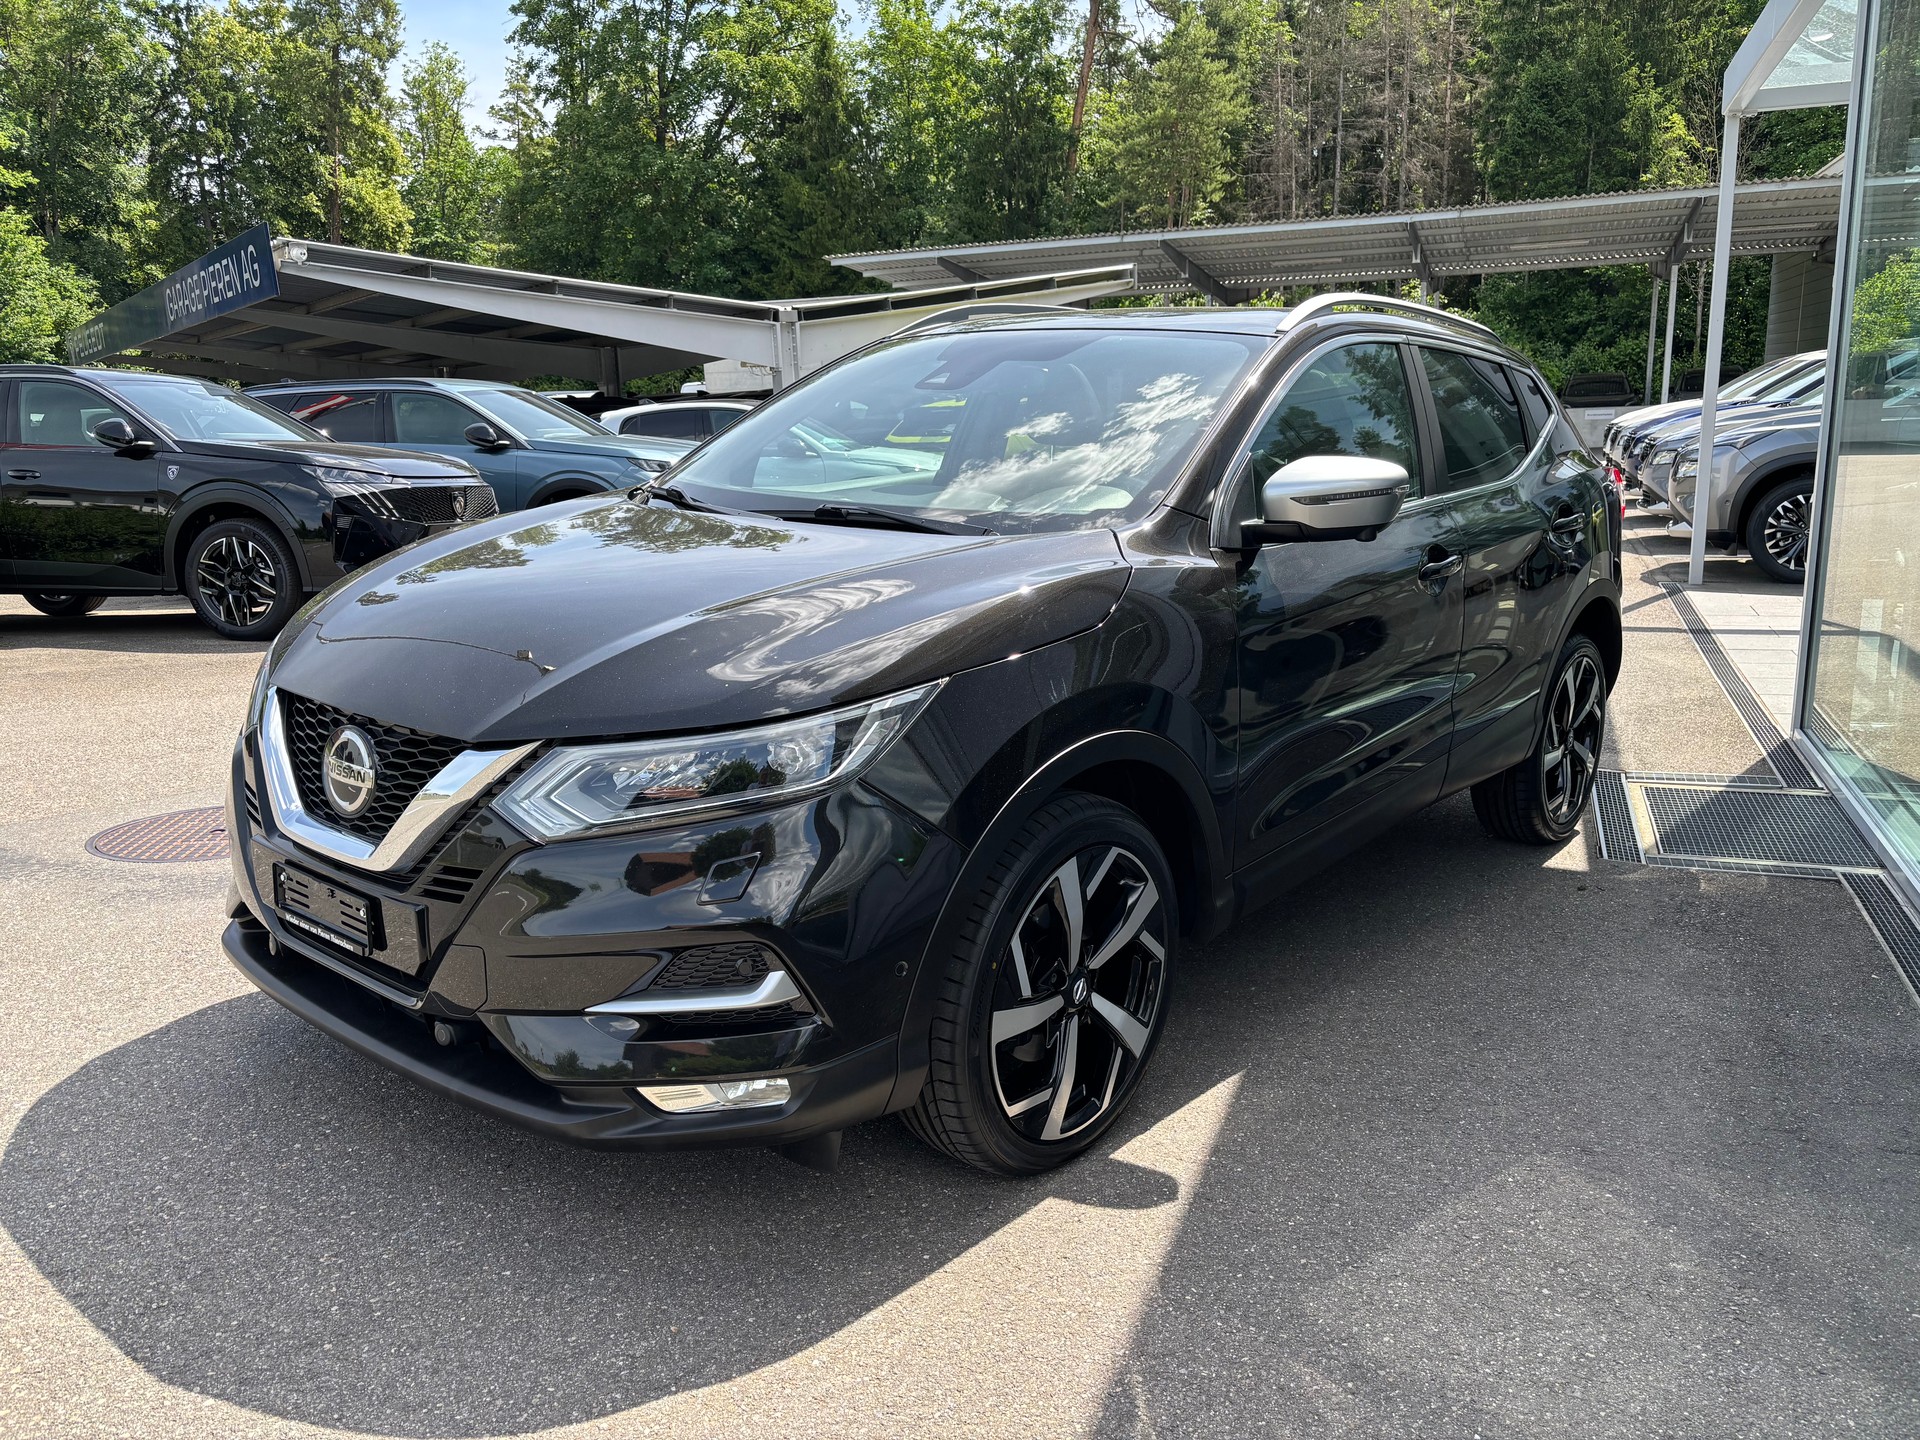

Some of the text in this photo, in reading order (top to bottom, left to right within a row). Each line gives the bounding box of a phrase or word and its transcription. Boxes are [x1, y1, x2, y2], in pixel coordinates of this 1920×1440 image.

[165, 244, 261, 321] GARAGE PIEREN AG
[328, 760, 366, 784] NISSAN
